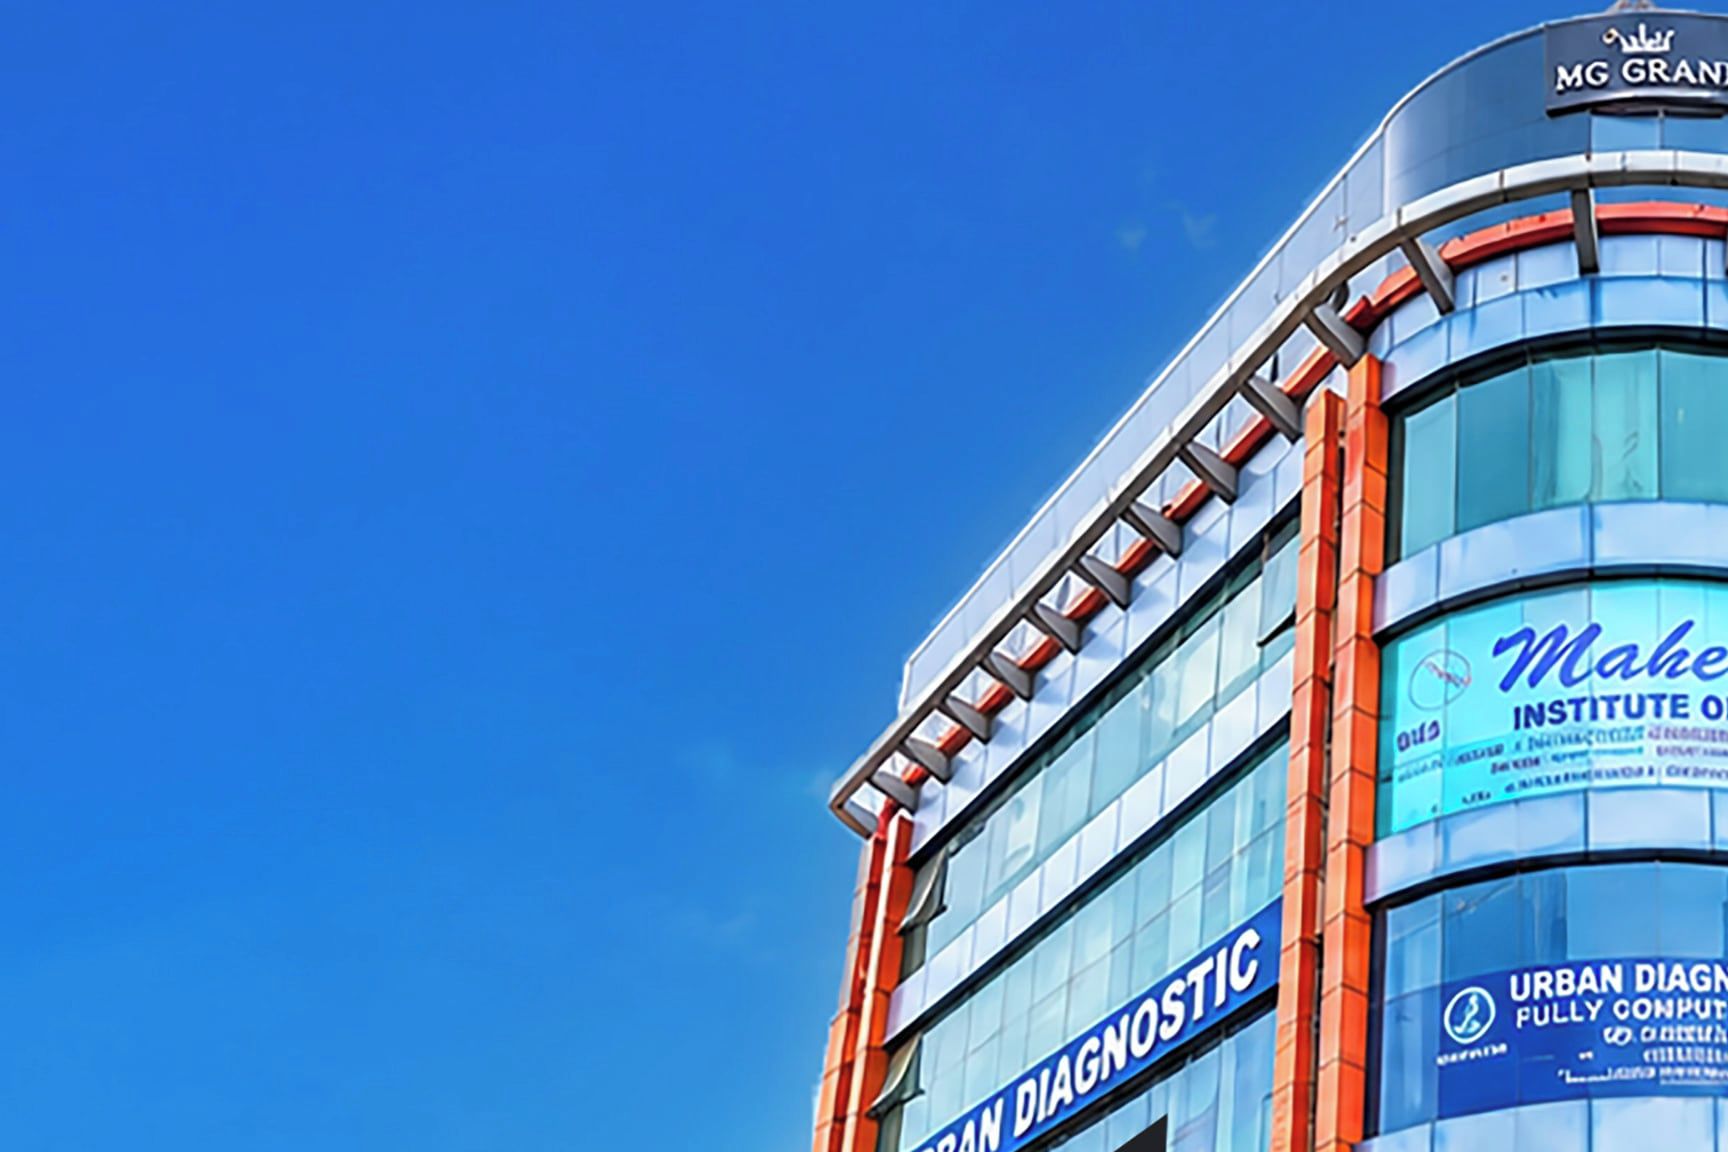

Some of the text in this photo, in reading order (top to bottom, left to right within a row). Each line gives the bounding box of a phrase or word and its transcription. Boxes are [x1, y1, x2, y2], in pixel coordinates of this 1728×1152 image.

[1556, 62, 1609, 91] MG
[1513, 692, 1690, 731] INSTITUTE
[1509, 965, 1623, 1002] URBAN
[1013, 928, 1261, 1138] DIAGNOSTIC
